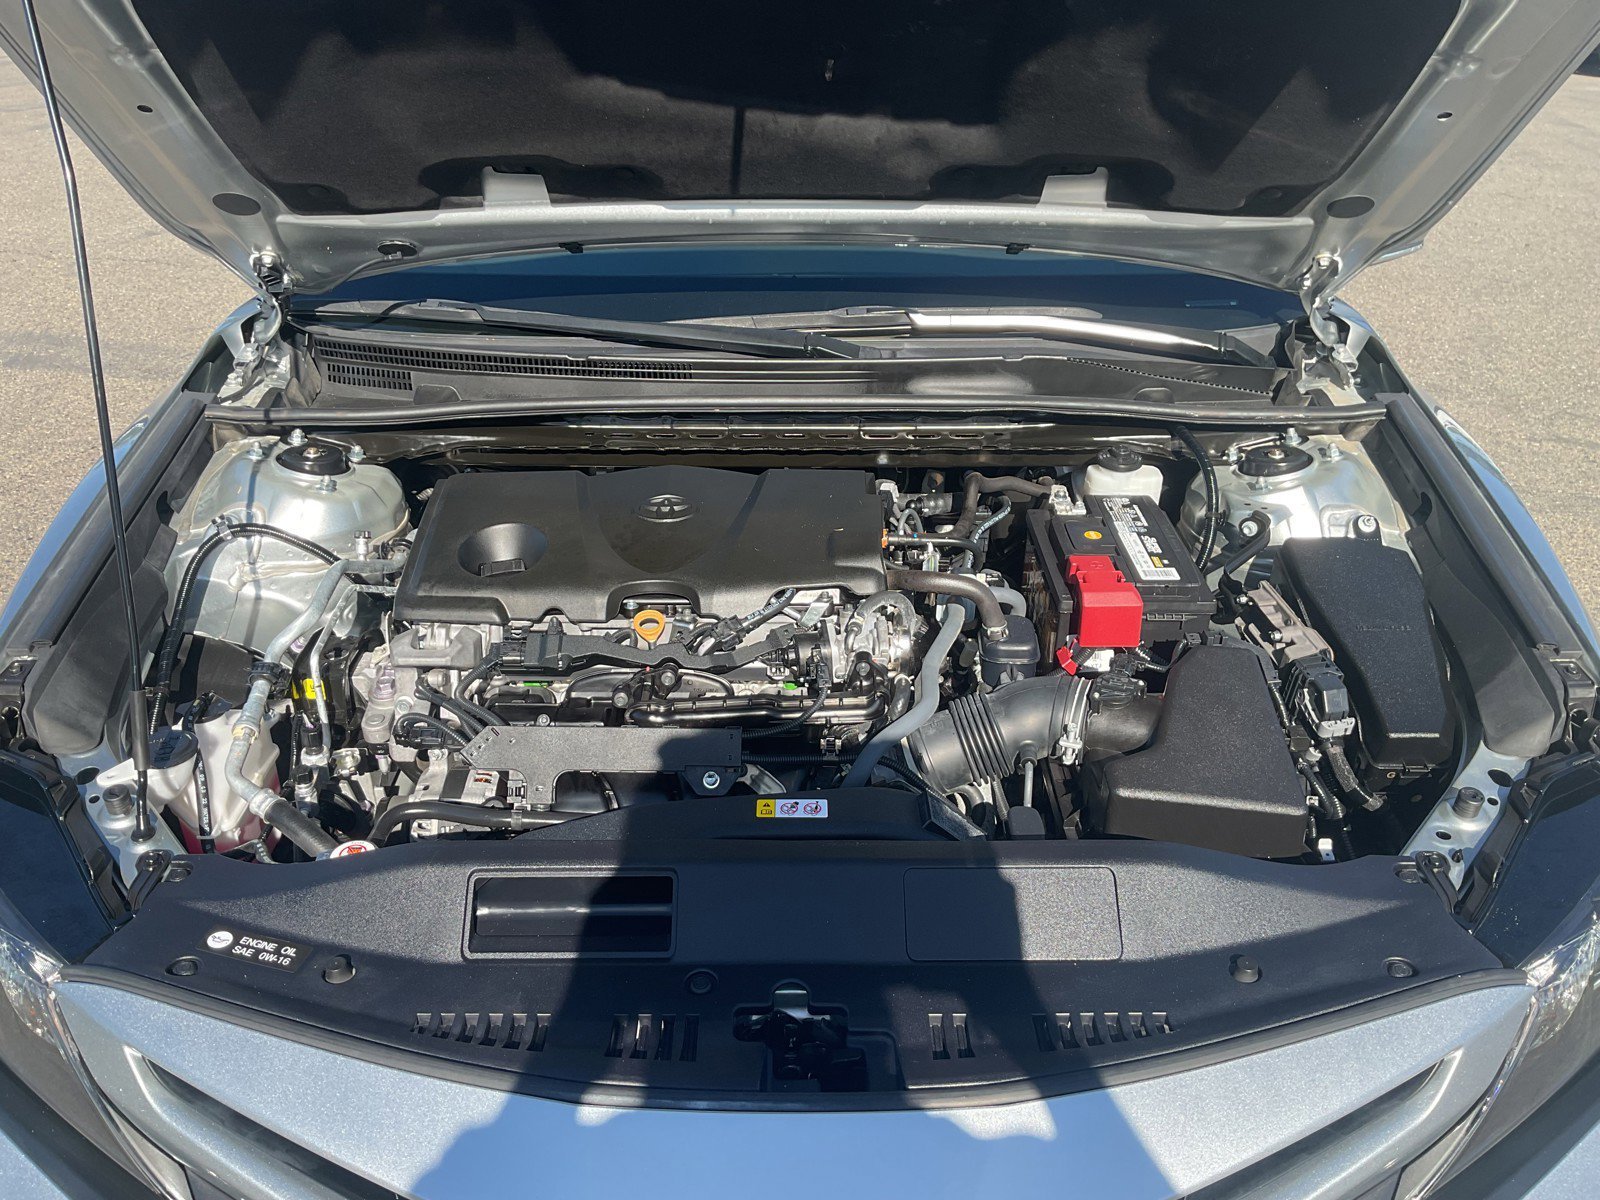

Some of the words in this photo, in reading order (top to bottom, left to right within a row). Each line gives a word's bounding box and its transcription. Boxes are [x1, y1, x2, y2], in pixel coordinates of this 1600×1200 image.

[232, 945, 255, 957] SAE
[258, 952, 292, 966] 0W-16
[239, 936, 278, 952] ENGINE
[280, 946, 297, 957] OIL
